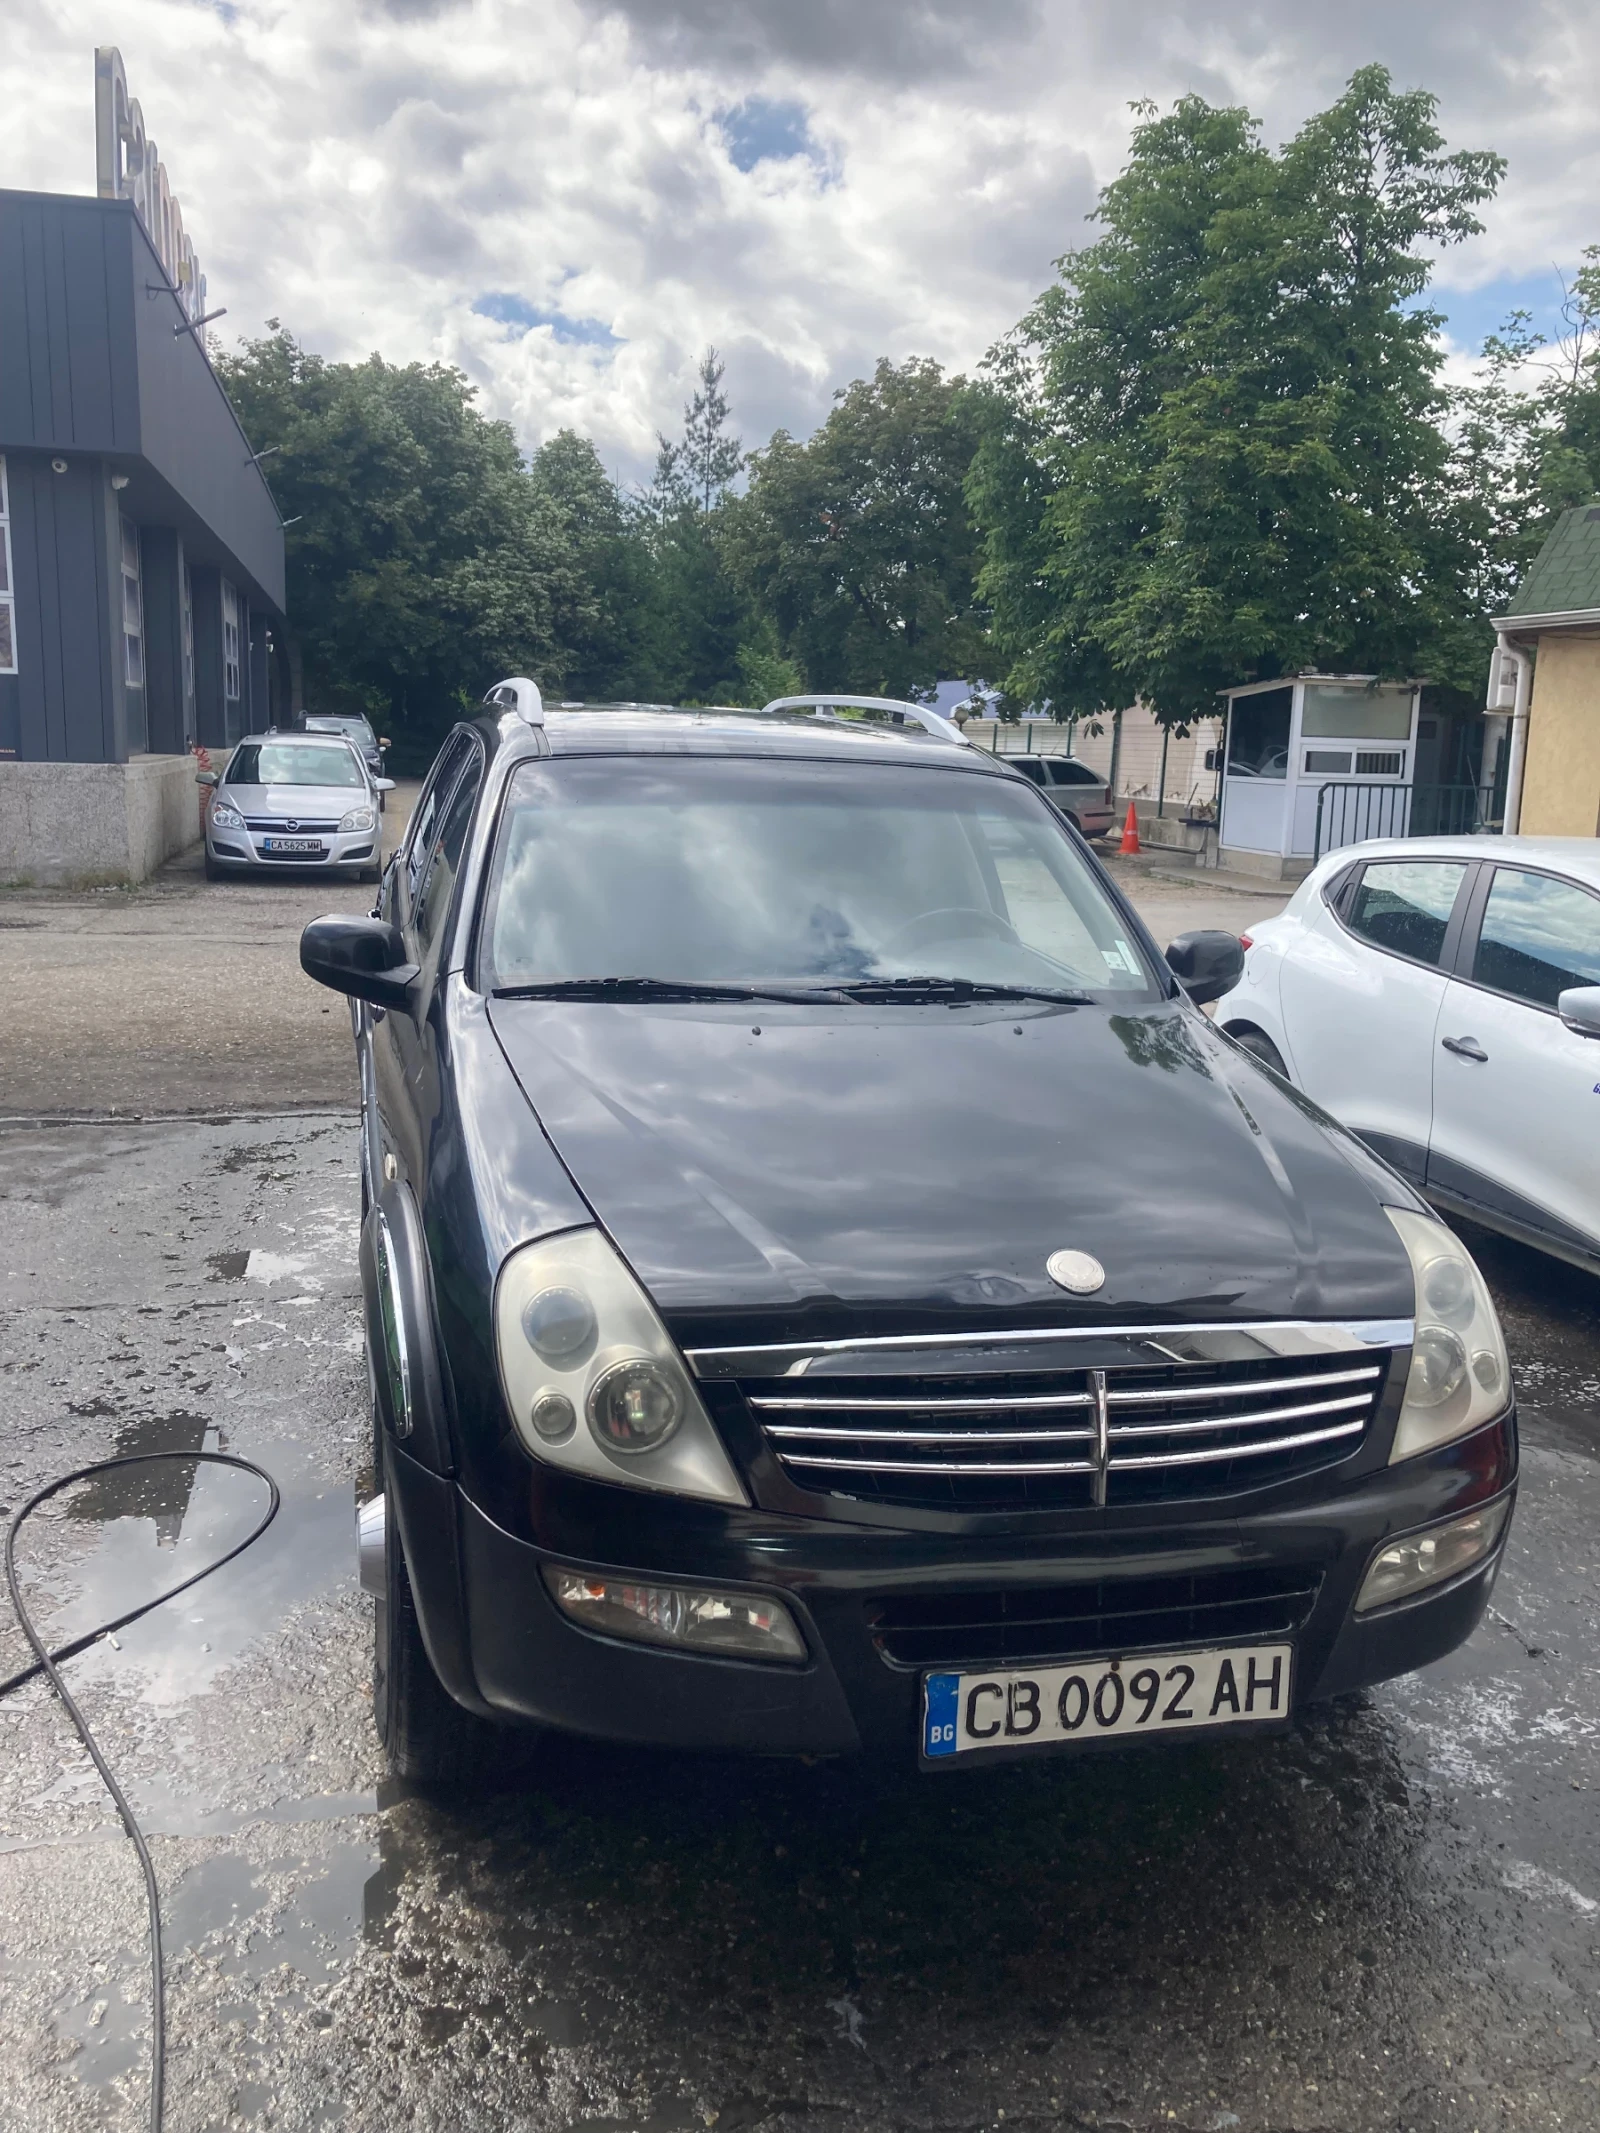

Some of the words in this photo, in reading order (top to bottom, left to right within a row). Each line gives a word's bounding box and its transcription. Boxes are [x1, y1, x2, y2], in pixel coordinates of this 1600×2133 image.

[271, 841, 283, 850] CA
[284, 841, 306, 851] 5625
[965, 1680, 1041, 1739] CB
[1057, 1664, 1195, 1731] 0092
[1209, 1655, 1282, 1716] AH
[930, 1723, 954, 1745] BG
